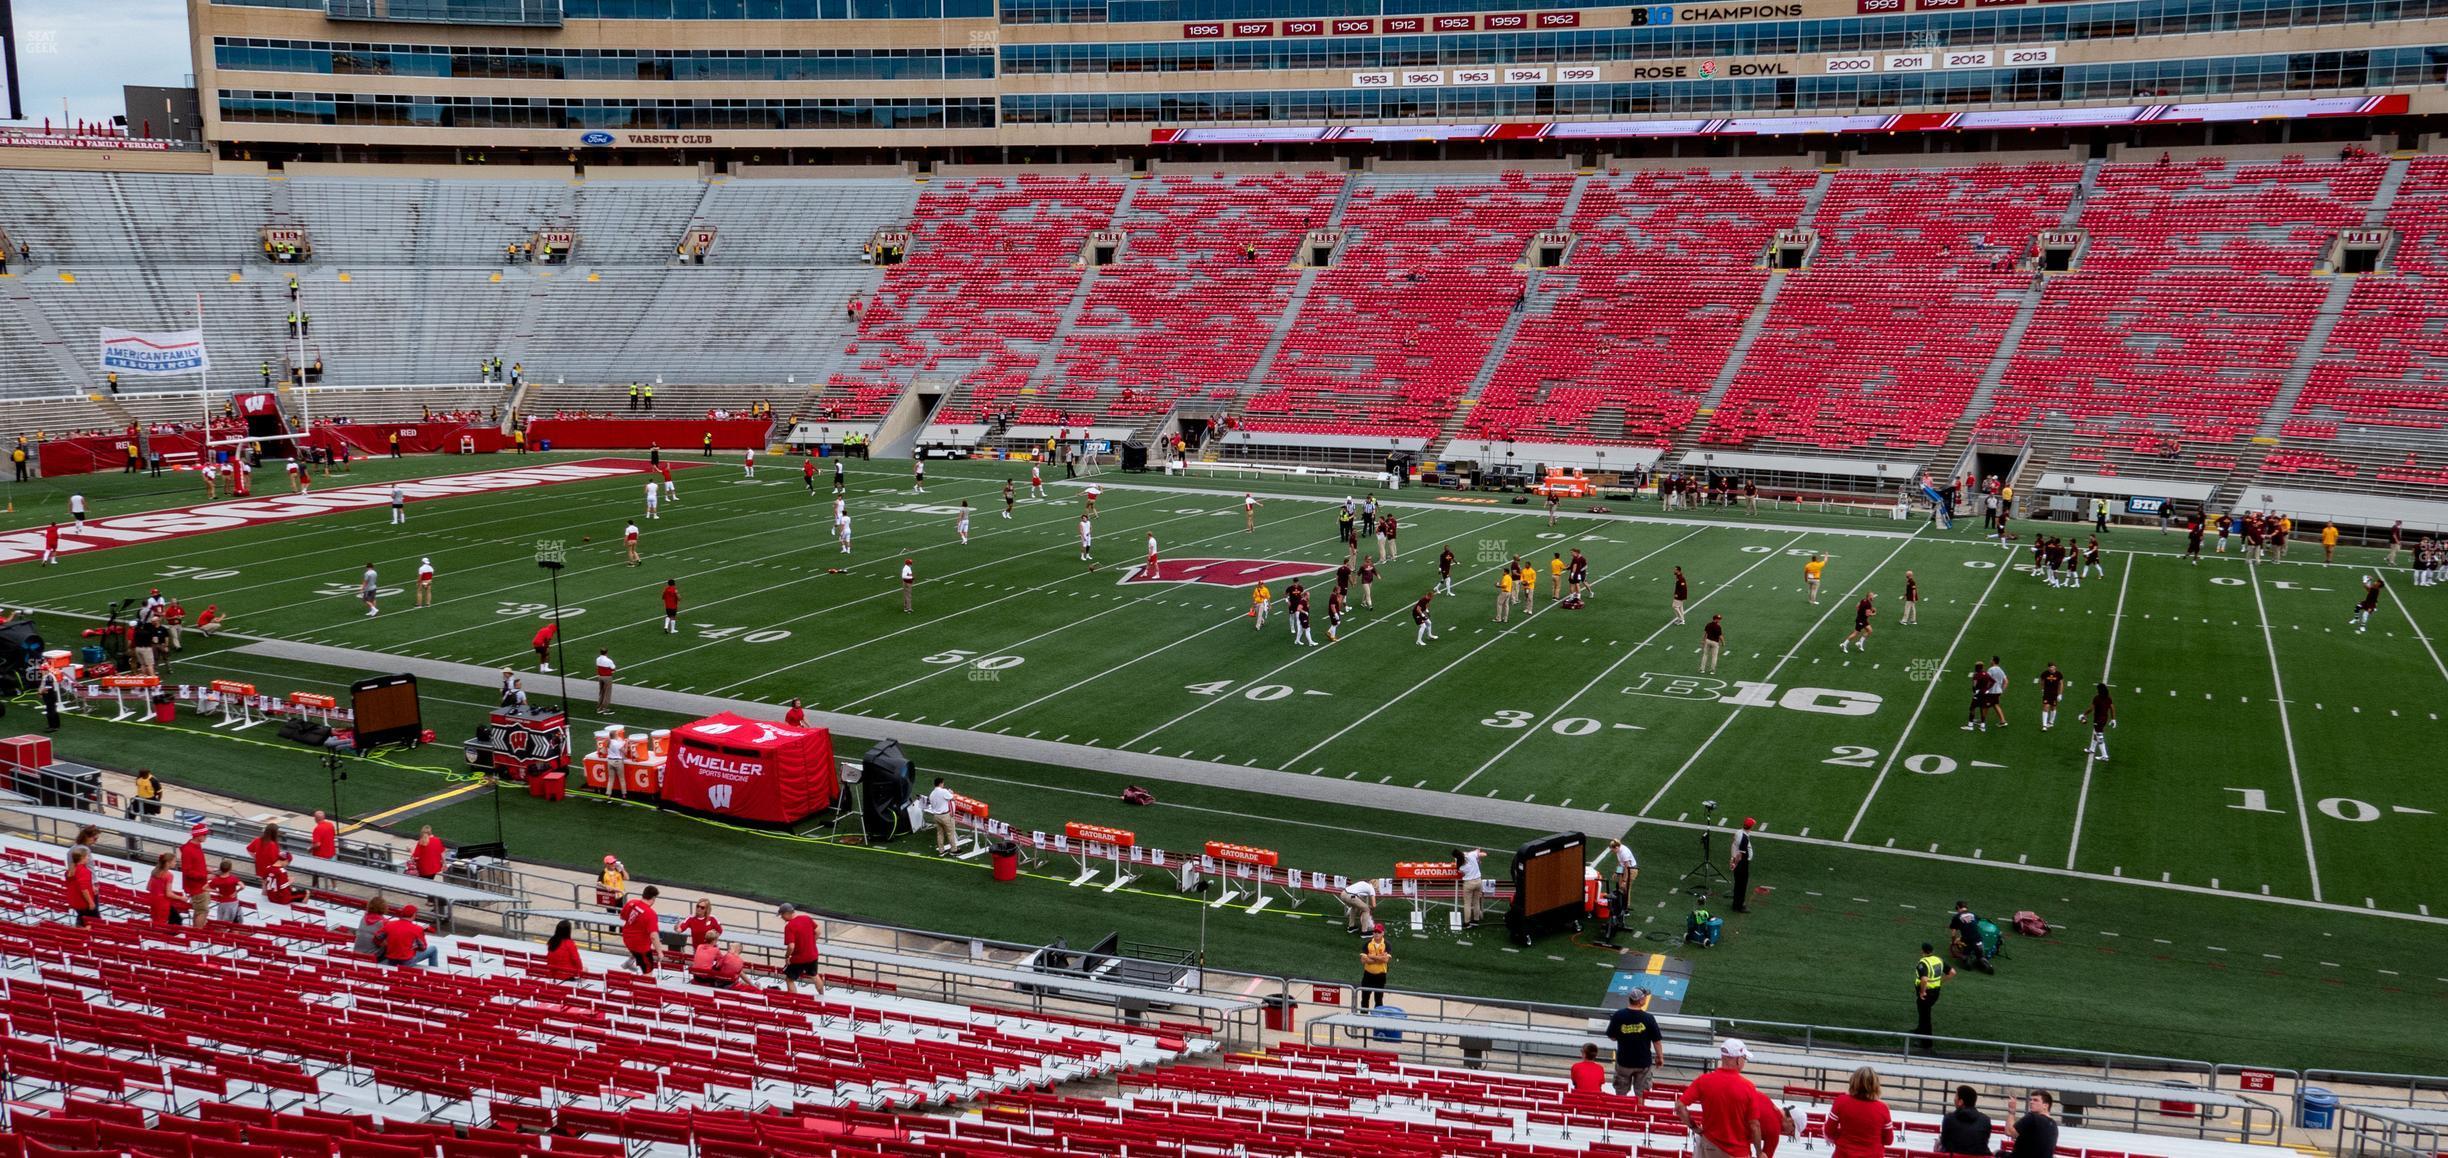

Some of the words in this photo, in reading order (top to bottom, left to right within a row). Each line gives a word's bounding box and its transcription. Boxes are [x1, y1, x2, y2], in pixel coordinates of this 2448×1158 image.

[1681, 5, 1803, 21] CHAMPIONS
[1439, 19, 1469, 28] 1952
[1490, 17, 1521, 26] 1959
[1542, 15, 1573, 24] 1962
[1189, 26, 1219, 35] 1896
[1238, 25, 1267, 34] 1897
[1289, 24, 1316, 33] 1901
[1337, 22, 1368, 32] 1906
[1390, 21, 1416, 30] 1912
[1950, 55, 1986, 66] 2012
[2012, 52, 2047, 62] 2013
[1828, 58, 1870, 71] 2000
[1893, 58, 1923, 68] 2011
[1511, 71, 1541, 81] 1994
[1562, 70, 1594, 79] 1999
[1634, 66, 1686, 79] ROSE
[1730, 63, 1788, 76] BOWL
[1359, 75, 1387, 84] 1953
[1407, 74, 1438, 83] 1960
[1459, 73, 1489, 82] 1963
[587, 134, 608, 143] Ford
[628, 135, 680, 144] VARSITY
[682, 136, 713, 144] CLUB
[86, 141, 120, 149] FAMILY
[122, 142, 165, 150] TERRACE
[106, 347, 162, 362] AMERICAN
[163, 347, 200, 361] FAMILY
[112, 358, 195, 370] INSURANCE
[400, 429, 417, 437] RED
[2131, 499, 2163, 511] BTN
[509, 731, 529, 753] W
[686, 753, 763, 776] MUELLER
[592, 764, 606, 782] G
[635, 769, 650, 787] G
[699, 768, 722, 778] SPORTS
[722, 772, 750, 783] MEDICINE
[708, 784, 732, 809] W
[1079, 830, 1116, 842] GATORADE
[1220, 848, 1259, 862] GATORADE
[2242, 1071, 2274, 1079] EMERGENCY
